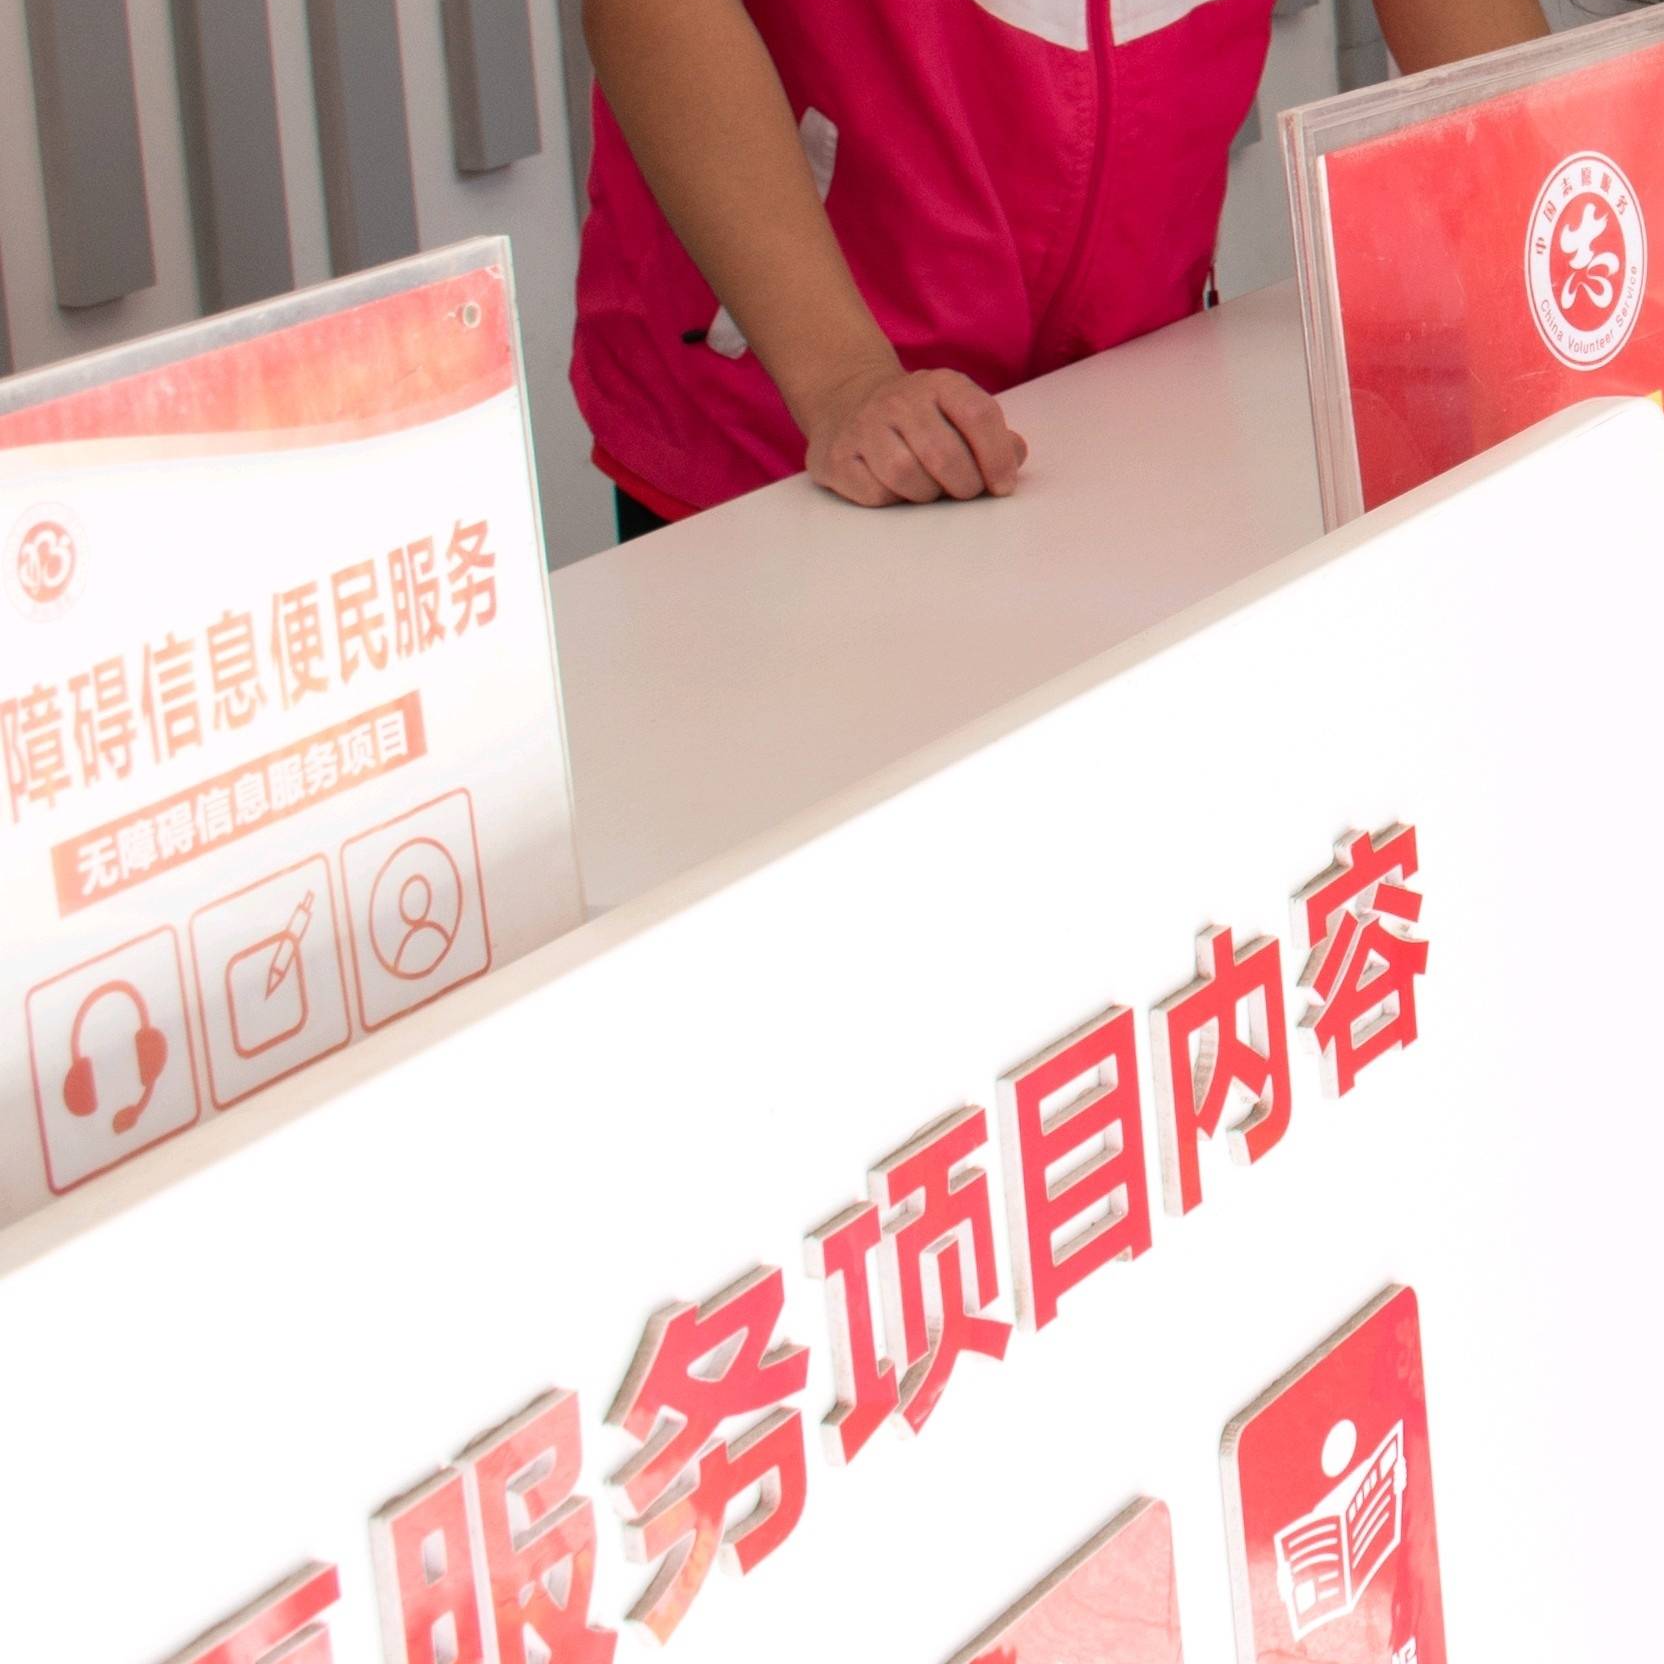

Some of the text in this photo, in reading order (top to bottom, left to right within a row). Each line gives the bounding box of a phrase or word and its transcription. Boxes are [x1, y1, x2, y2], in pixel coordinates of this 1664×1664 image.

[1540, 265, 1639, 355] China Volunteer Service
[77, 708, 410, 897] 无障碍信息服务项目
